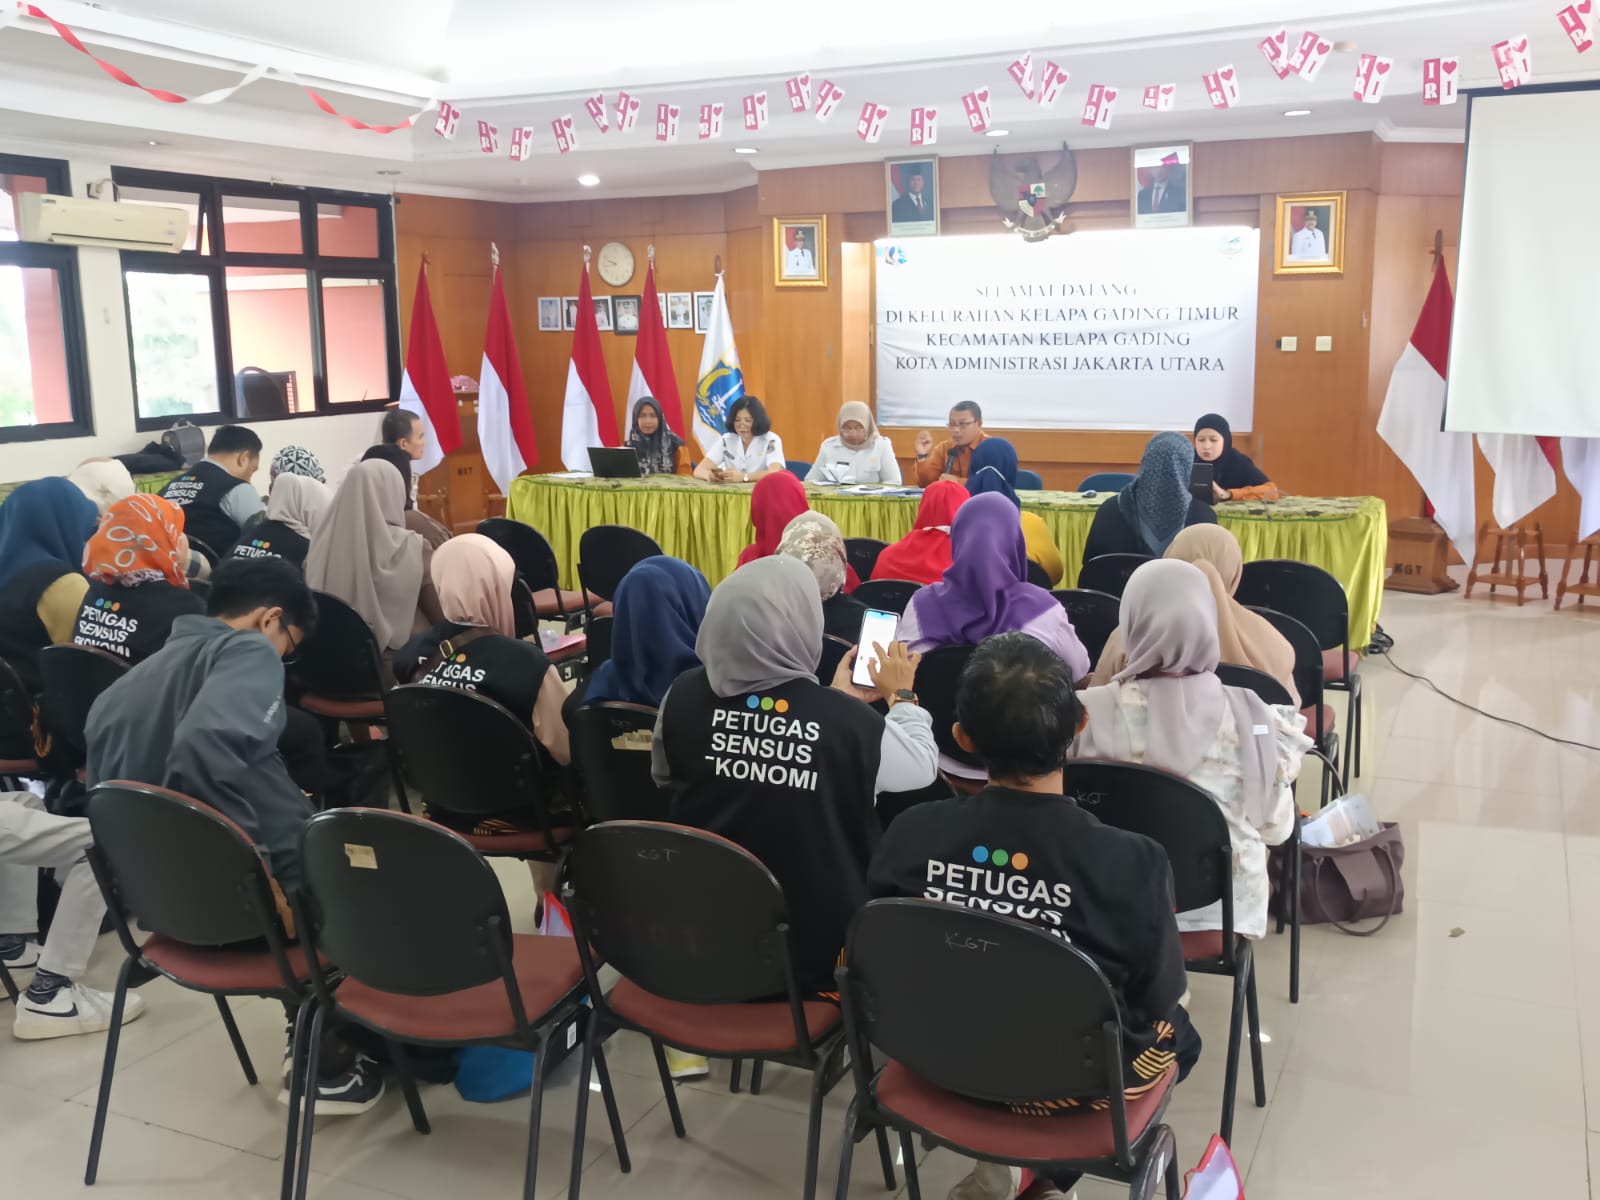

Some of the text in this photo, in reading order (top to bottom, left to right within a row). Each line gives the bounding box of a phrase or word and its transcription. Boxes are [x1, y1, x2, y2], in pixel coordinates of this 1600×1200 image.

[886, 306, 1239, 323] DI KELURAHAN KELAPA GADING TIMUR
[926, 331, 1191, 346] KECAMATAN KELAPA GADING
[896, 356, 1225, 371] KOTA ADMINISTRASI JAKARTA UTARA
[79, 620, 129, 643] SENSUS
[81, 605, 138, 633] PETUGAS
[418, 656, 487, 682] TUGAS
[712, 708, 820, 742] PETUGAS
[711, 733, 813, 764] SENSUS
[705, 755, 818, 791] KONOMI
[926, 859, 1072, 908] PETUGAS
